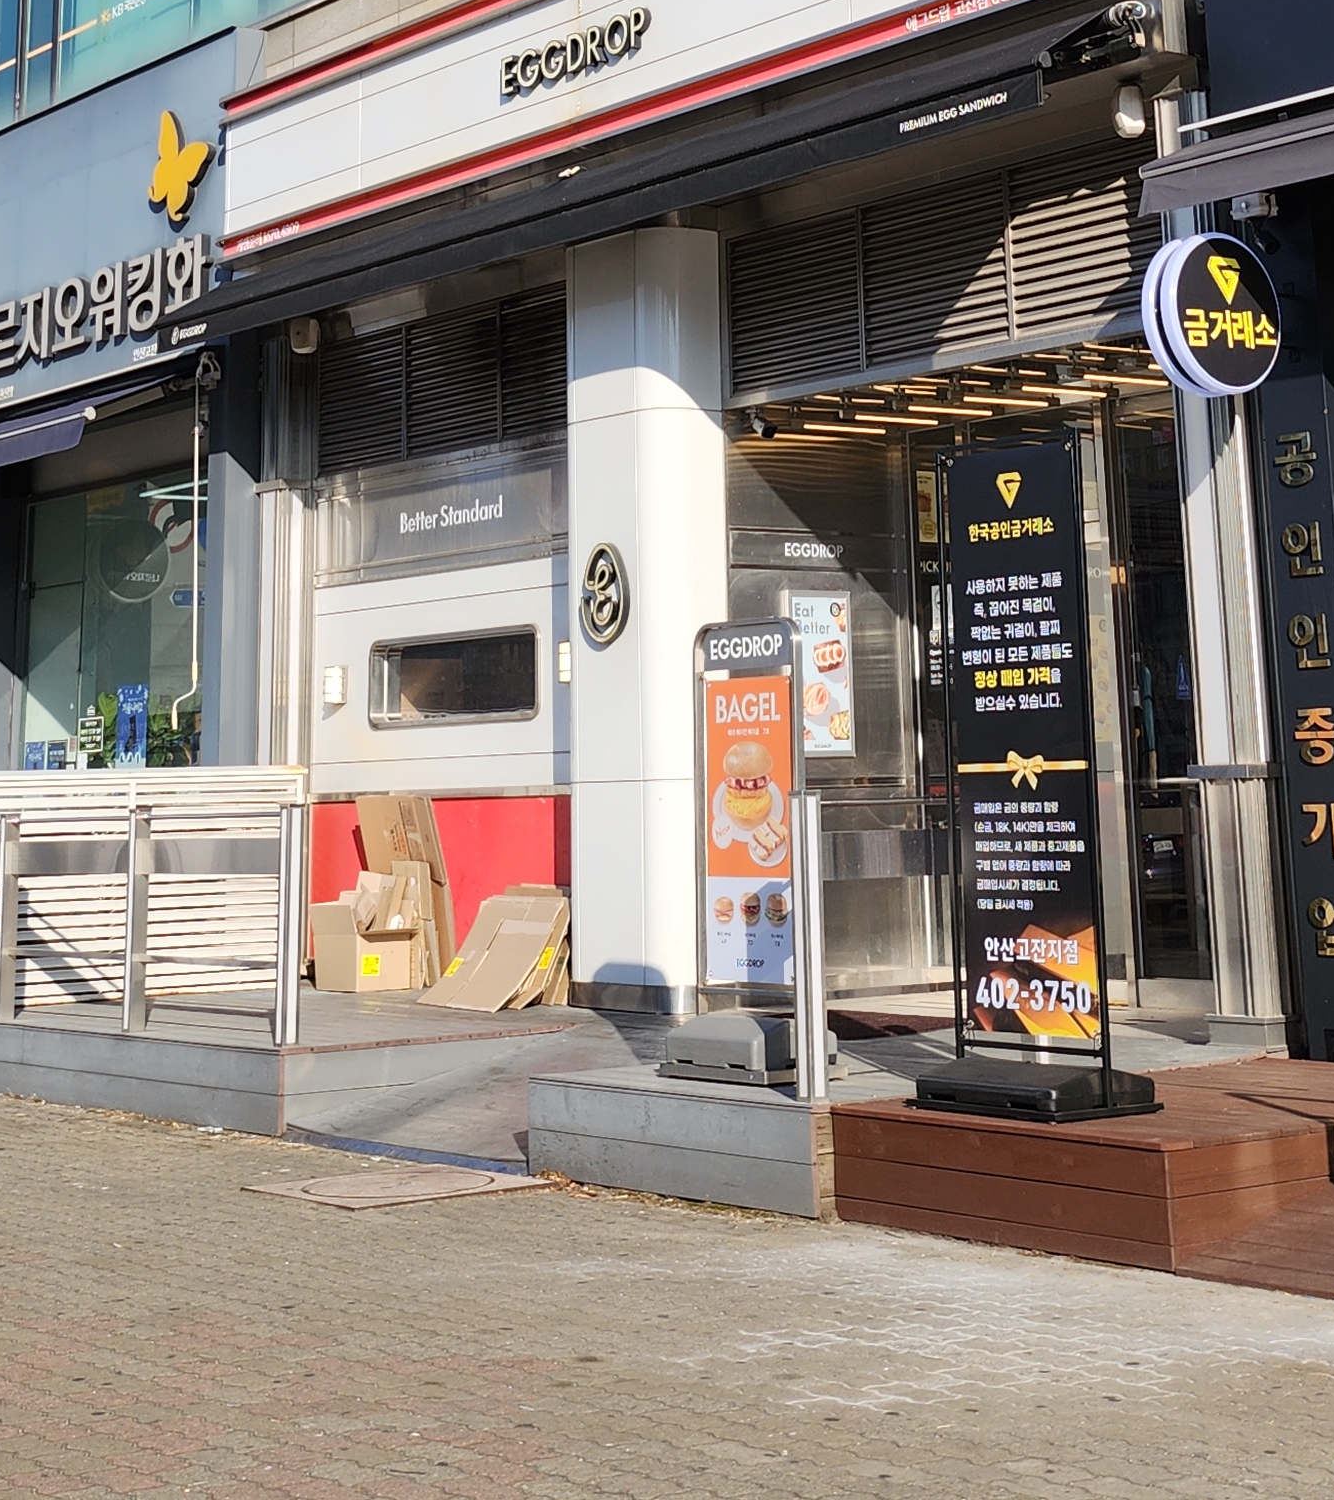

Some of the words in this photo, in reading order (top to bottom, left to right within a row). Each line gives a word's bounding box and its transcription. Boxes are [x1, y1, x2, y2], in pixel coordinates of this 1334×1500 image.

[905, 3, 951, 31] 에그드랍
[500, 6, 652, 98] EGGDROP
[899, 112, 938, 134] PREMIUM
[938, 105, 958, 123] EGG
[958, 91, 1008, 116] SANDWICH
[1183, 308, 1278, 352] 금거래소
[399, 504, 439, 535] Better
[440, 494, 504, 528] Standard
[968, 517, 1055, 543] 한국공인금거래소
[783, 542, 844, 560] EGGDROP
[966, 577, 1006, 596] 사용하지
[1008, 575, 1039, 592] 못하는
[1041, 571, 1063, 588] 제품
[794, 602, 815, 619] Eat
[709, 634, 783, 661] EGGDROP
[962, 649, 992, 666] 변형이
[1008, 646, 1028, 663] 모든
[1031, 642, 1073, 661] 제품들도
[975, 670, 998, 689] 정상
[1001, 668, 1024, 687] 매입
[1027, 666, 1061, 686] 가격을
[715, 692, 782, 724] BAGEL
[1019, 692, 1063, 710] 있습니다.
[984, 936, 1080, 966] 안산고잔지점
[975, 977, 1092, 1014] 402-3750
